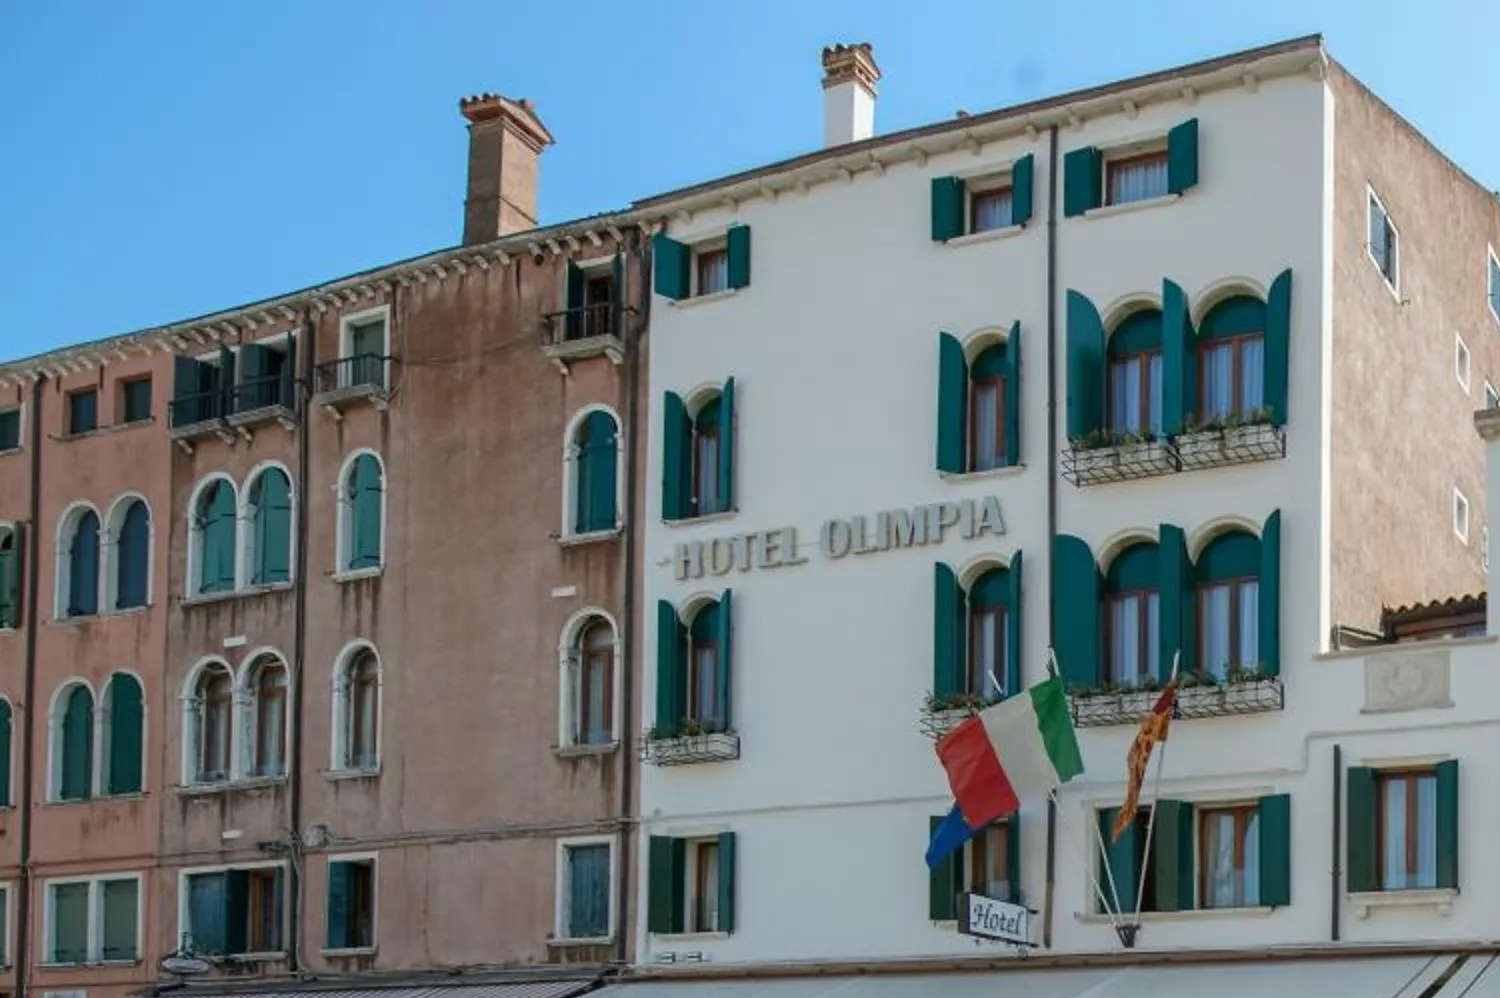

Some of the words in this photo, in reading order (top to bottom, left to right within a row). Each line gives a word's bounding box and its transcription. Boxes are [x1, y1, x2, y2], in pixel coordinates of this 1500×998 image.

[674, 526, 808, 581] HOTEL
[822, 496, 1006, 559] OLIMPIA
[971, 903, 1024, 935] Hotel
